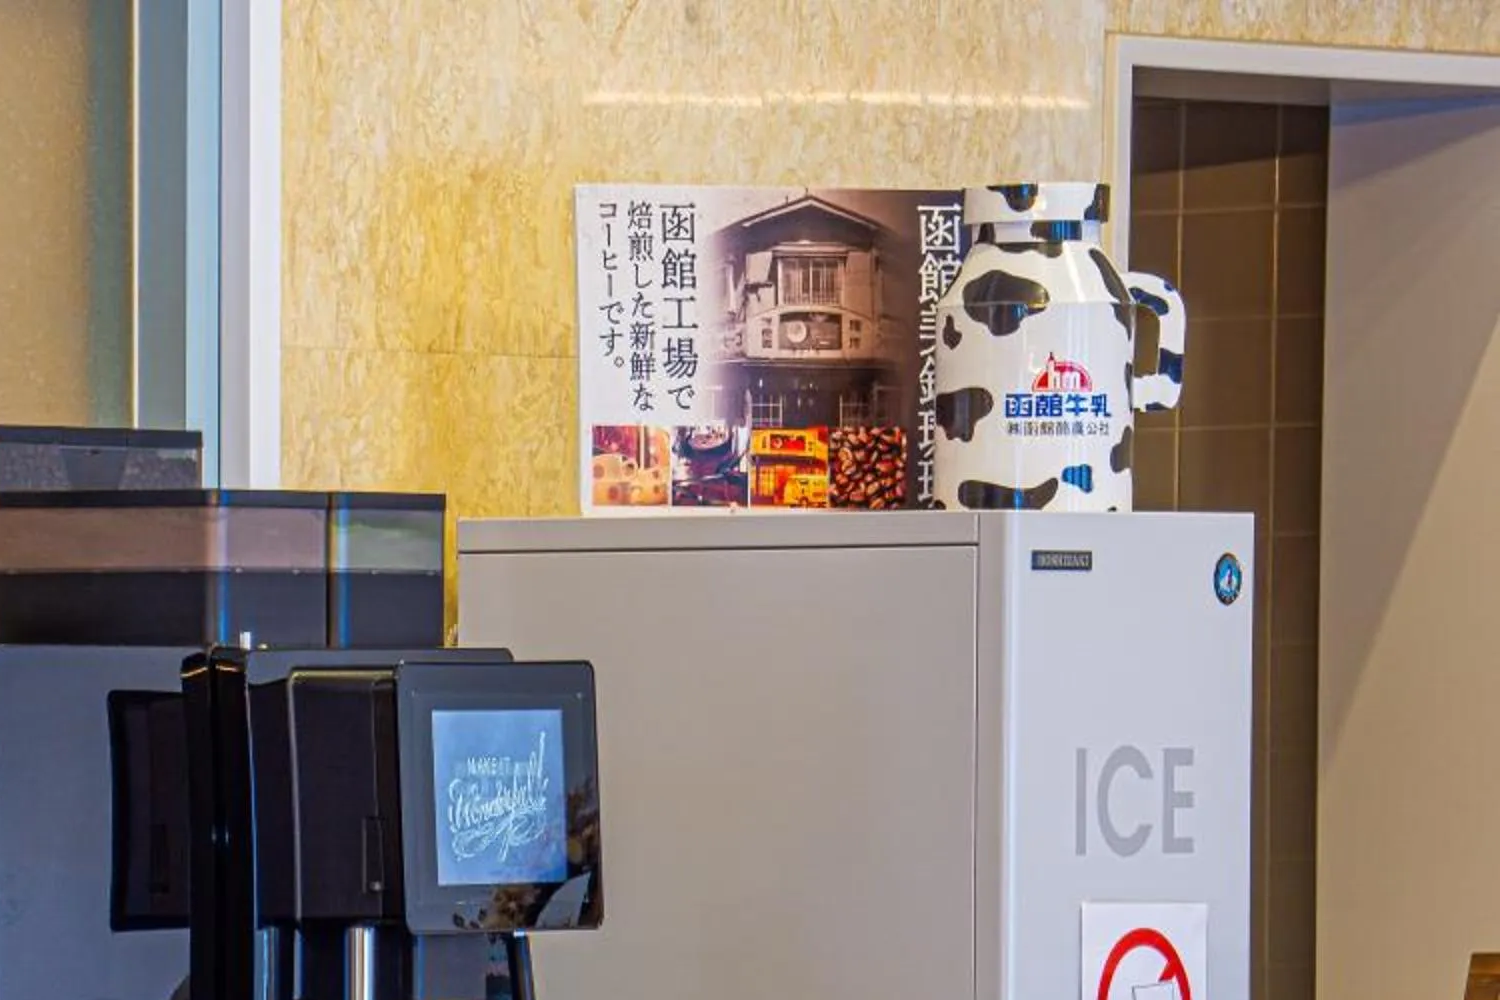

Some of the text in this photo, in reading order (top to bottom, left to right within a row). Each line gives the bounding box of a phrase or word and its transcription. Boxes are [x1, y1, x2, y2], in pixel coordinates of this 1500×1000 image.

[599, 203, 625, 368] コーヒーです。
[627, 201, 657, 411] 焙煎した新鮮な
[659, 203, 699, 410] 函館工場で
[1005, 394, 1112, 418] 函館牛乳
[1075, 745, 1195, 858] ICE
